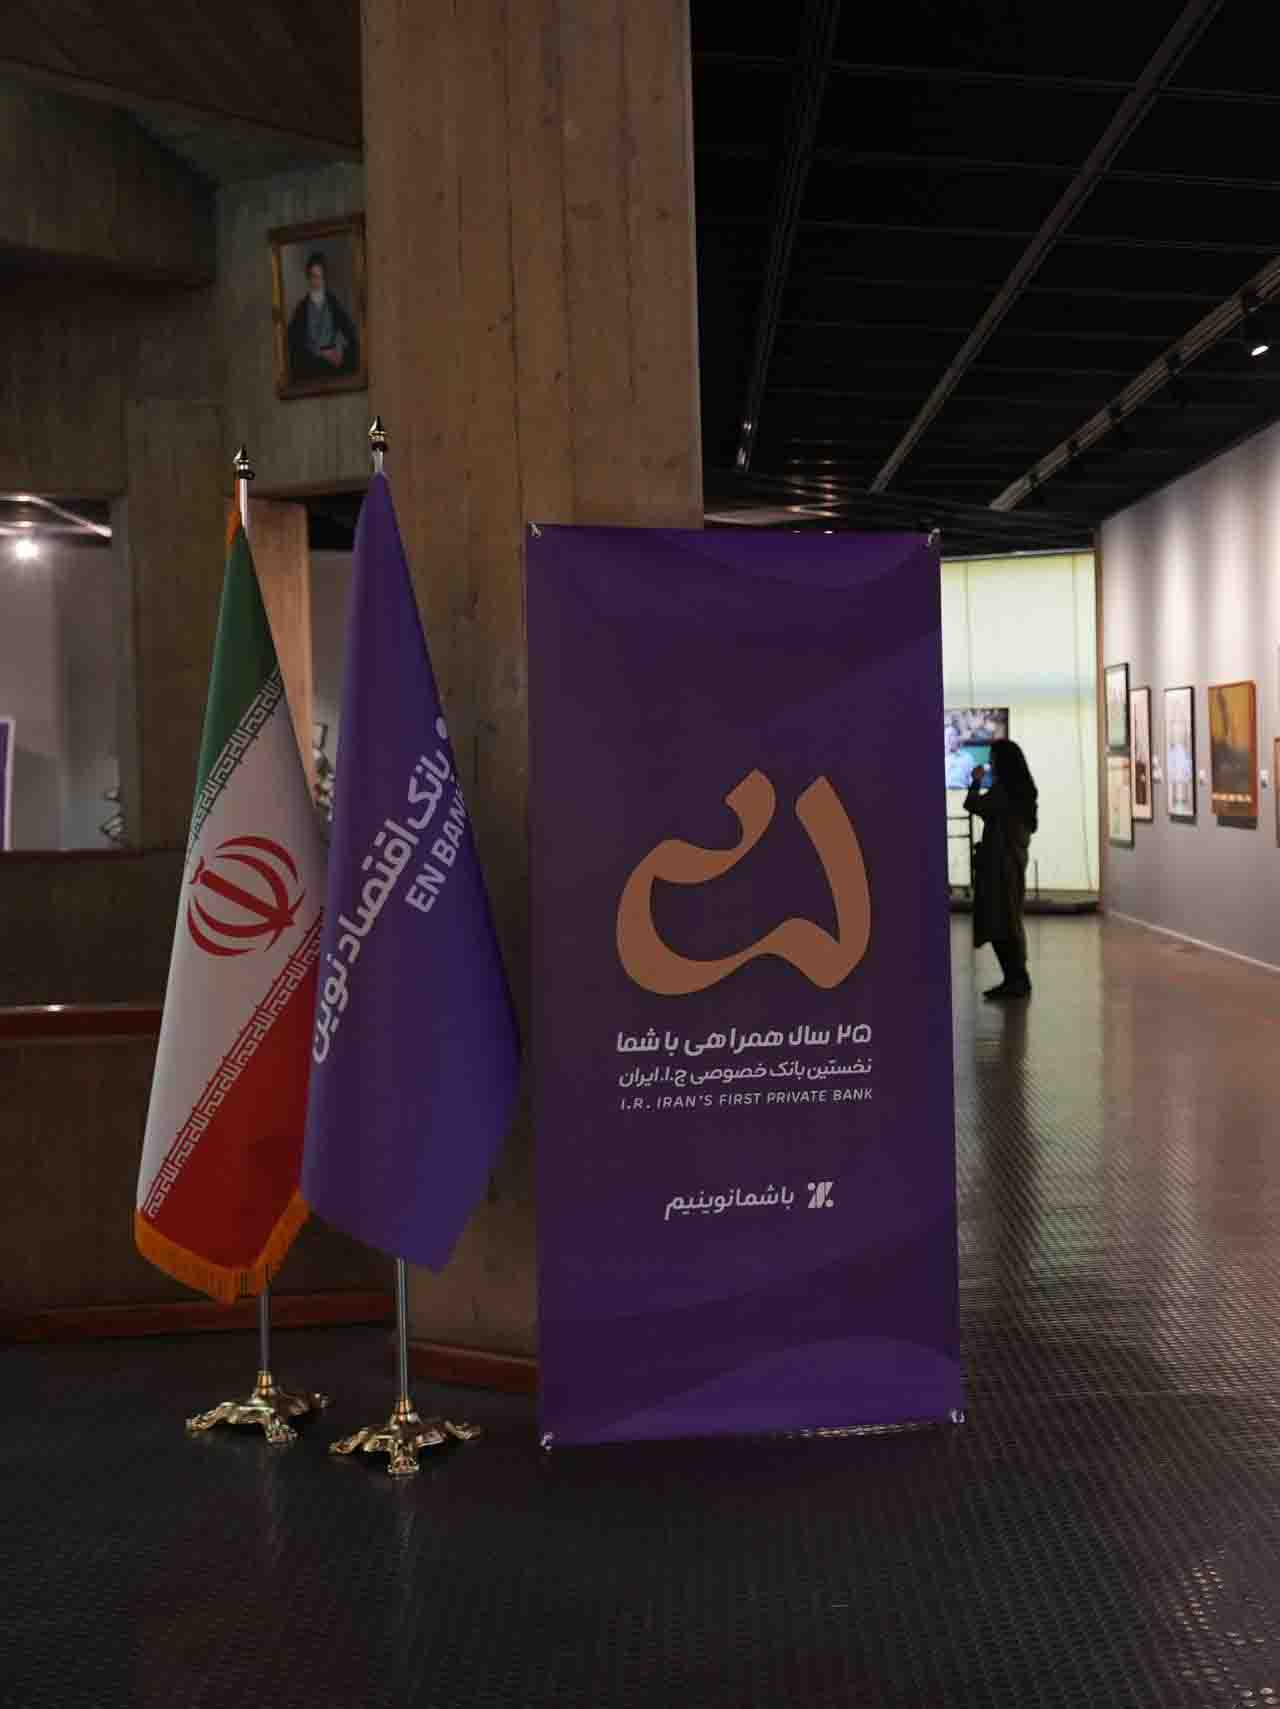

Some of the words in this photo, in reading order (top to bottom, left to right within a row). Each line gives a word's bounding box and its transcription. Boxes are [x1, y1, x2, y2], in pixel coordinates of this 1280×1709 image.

[407, 750, 455, 830] بانک
[338, 818, 420, 964] اقتصاد
[405, 862, 447, 912] EN
[312, 952, 349, 1064] نوین
[616, 1026, 661, 1053] شما
[664, 1031, 680, 1057] با
[684, 1027, 784, 1056] همراهی
[788, 1024, 831, 1046] سال
[836, 1023, 872, 1044] ۲۵
[690, 1063, 767, 1085] خصوصی
[769, 1060, 805, 1080] بانک
[806, 1057, 872, 1080] نخستین
[620, 1097, 652, 1111] I.R.
[719, 1092, 761, 1106] FIRST
[767, 1089, 828, 1104] PRIVATE
[832, 1087, 872, 1102] BANK
